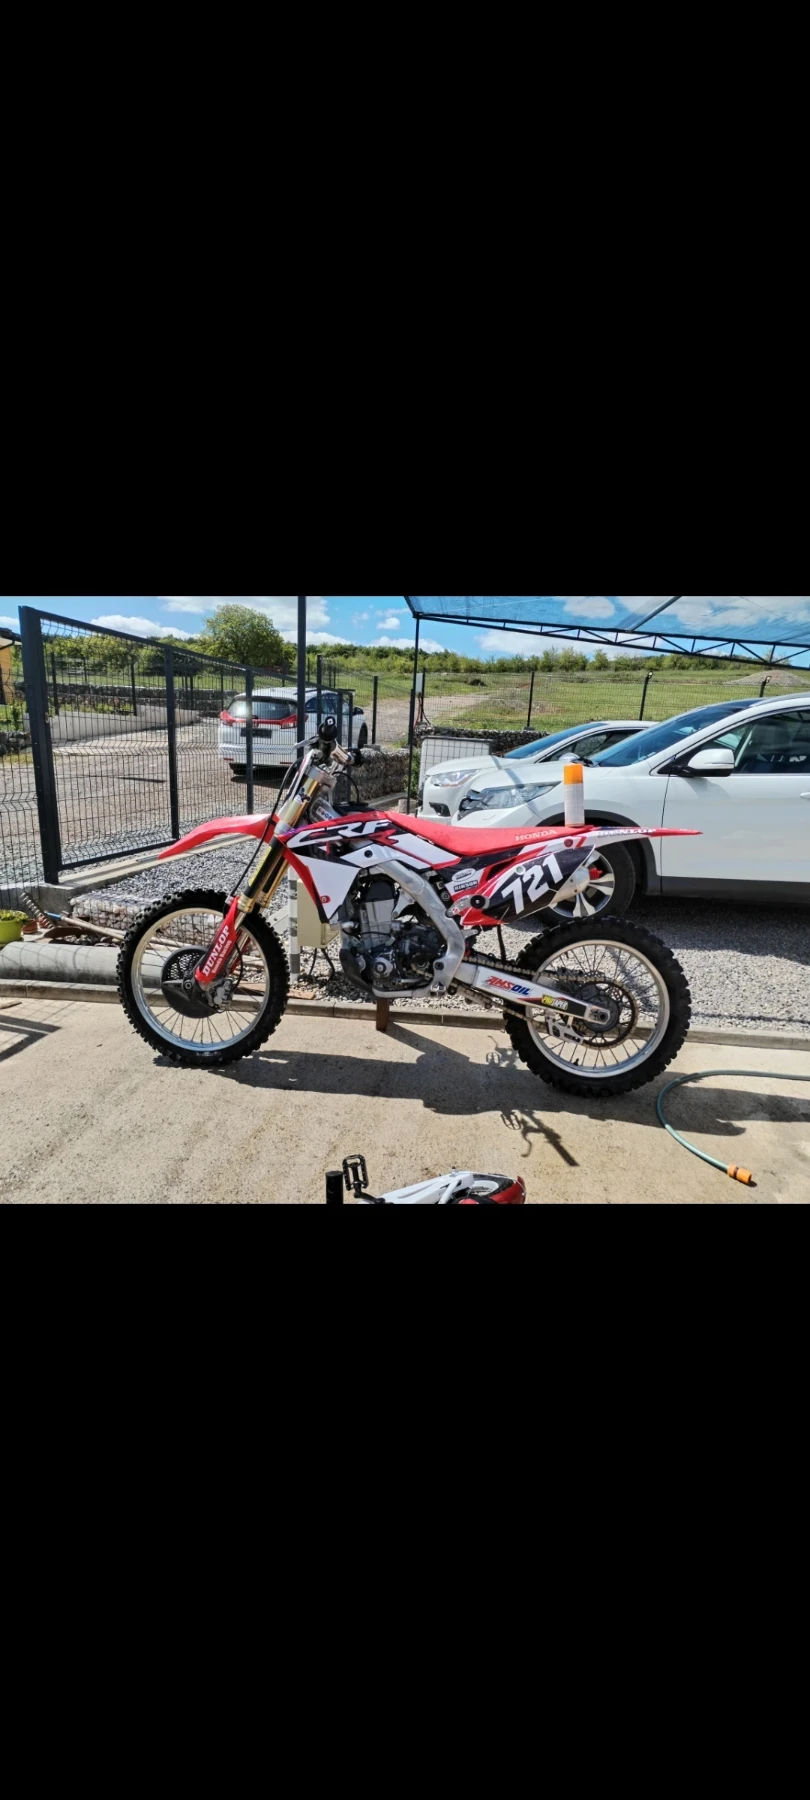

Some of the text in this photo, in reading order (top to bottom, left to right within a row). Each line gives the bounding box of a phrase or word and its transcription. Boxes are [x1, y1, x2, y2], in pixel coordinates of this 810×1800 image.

[514, 829, 558, 841] HONDA
[501, 853, 563, 915] 721
[202, 924, 229, 977] DUNLOP
[485, 975, 532, 996] AMSOIL
